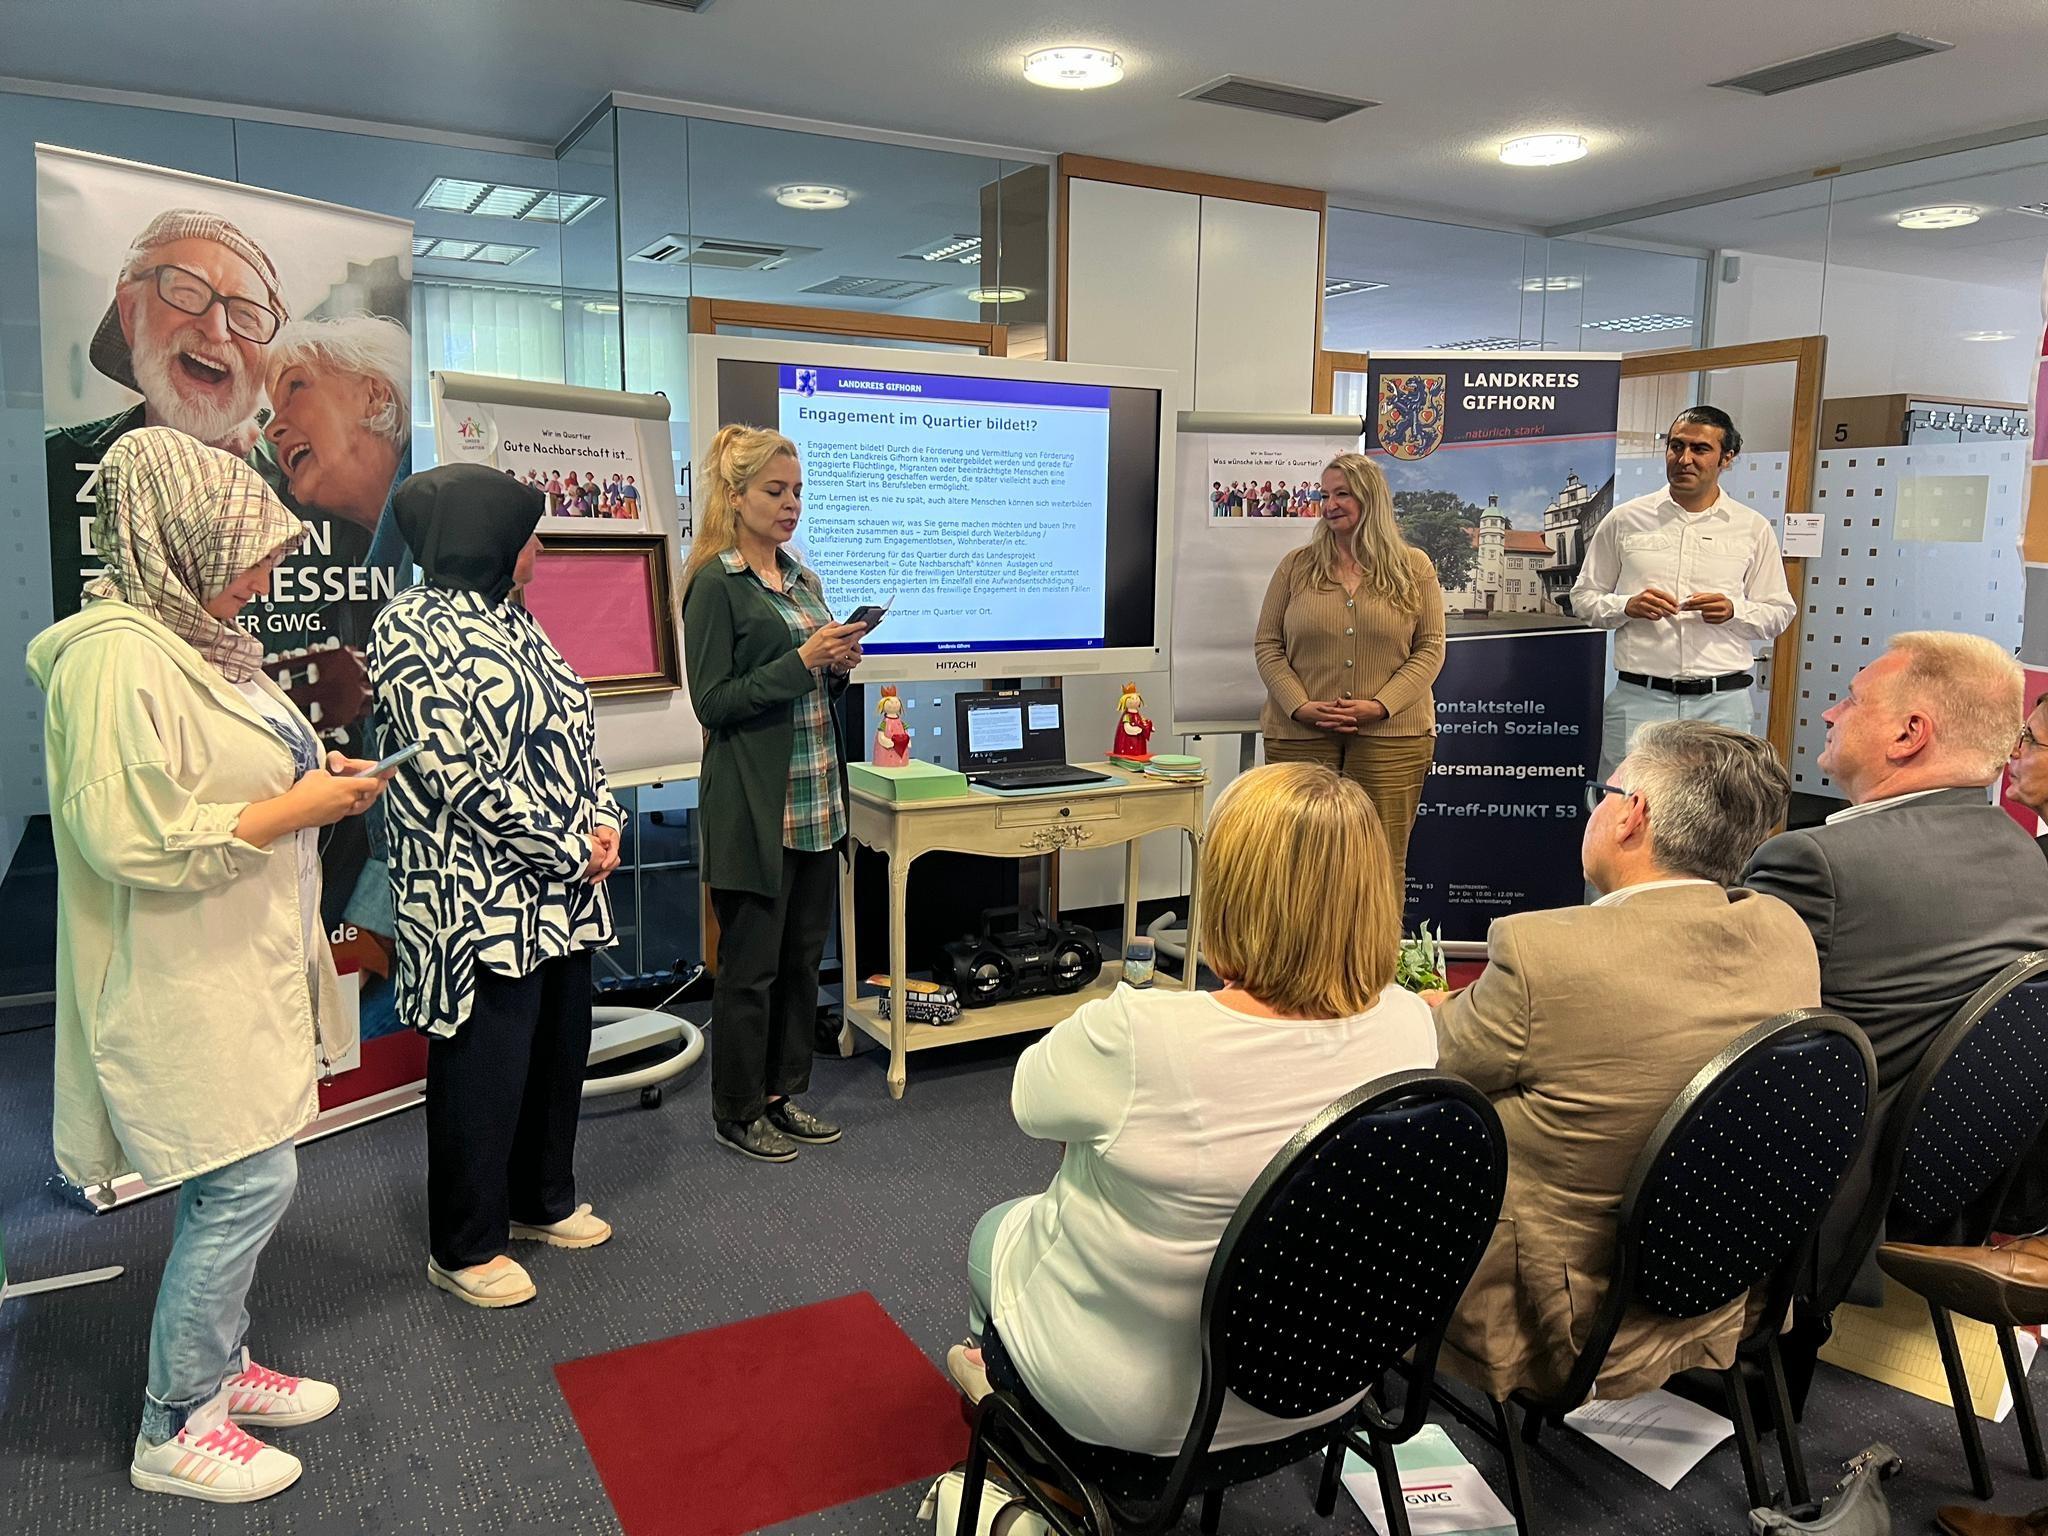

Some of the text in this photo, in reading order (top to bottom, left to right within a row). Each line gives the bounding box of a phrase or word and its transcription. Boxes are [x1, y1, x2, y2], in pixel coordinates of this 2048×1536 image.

[839, 380, 922, 393] LANDKREIS GIFHORN
[1464, 373, 1579, 388] LANDKREIS
[1462, 395, 1555, 410] GIFHORN
[799, 407, 1038, 431] Engagement im Quartier bildet!?
[563, 432, 592, 440] Quartier
[1514, 425, 1545, 436] stark!
[1834, 424, 1848, 442] 5
[504, 441, 530, 452] Gute
[534, 443, 609, 458] Nachbarschaft
[808, 441, 857, 451] Engagement
[860, 443, 884, 452] bildet!
[926, 446, 963, 456] Förderung
[982, 450, 1022, 458] Vermittlung
[1040, 452, 1074, 460] Förderung
[850, 452, 888, 460] Landkreis
[920, 455, 938, 463] kann
[941, 457, 992, 466] weitergebildet
[808, 461, 850, 469] engagierte
[852, 462, 897, 471] Flüchtlinge,
[900, 464, 937, 472] Migranten
[958, 467, 1012, 476] beeinträchtigte
[1014, 468, 1048, 476] Menschen
[808, 469, 884, 480] Grundqualifizierung
[887, 472, 928, 481] geschaffen
[930, 475, 960, 484] werden,
[975, 476, 998, 484] später
[1000, 476, 1030, 484] vielleicht
[808, 478, 844, 486] besseren
[882, 481, 926, 490] Berufsleben
[929, 484, 970, 492] ermöglicht.
[826, 504, 872, 512] engagieren.
[829, 494, 856, 502] Lernen
[906, 496, 926, 505] spät,
[1052, 500, 1092, 508] weiterbilden
[808, 517, 856, 525] Gemeinsam
[858, 518, 890, 526] schauen
[938, 522, 960, 530] gerne
[808, 526, 854, 536] Fähigkeiten
[942, 529, 970, 537] Beispiel
[994, 530, 1041, 538] Weiterbildung
[808, 535, 862, 544] Qualifizierung
[884, 537, 956, 546] Engagementlotsen,
[958, 538, 1012, 546] Wohnberater/in
[846, 550, 886, 559] Förderung
[916, 551, 948, 559] Quartier
[986, 552, 1036, 560] Landesprojekt
[1006, 560, 1038, 568] Auslagen
[915, 568, 954, 577] freiwilligen
[1018, 569, 1048, 577] Begleiter
[247, 566, 395, 602] ESSEN
[882, 578, 928, 586] engagierten
[942, 576, 973, 584] Einzelfall
[992, 577, 1074, 586] Aufwandsentschädigung
[846, 586, 876, 594] werden,
[936, 586, 971, 594] freiwillige
[974, 586, 1018, 594] Engagement
[934, 608, 963, 617] Quartier
[266, 613, 326, 632] GWG.
[1434, 700, 1545, 714] ontaktstelle
[1504, 722, 1580, 736] Soziales
[1428, 762, 1585, 780] iersmanagement
[1556, 805, 1578, 818] 53
[1405, 1492, 1452, 1504] GWG
